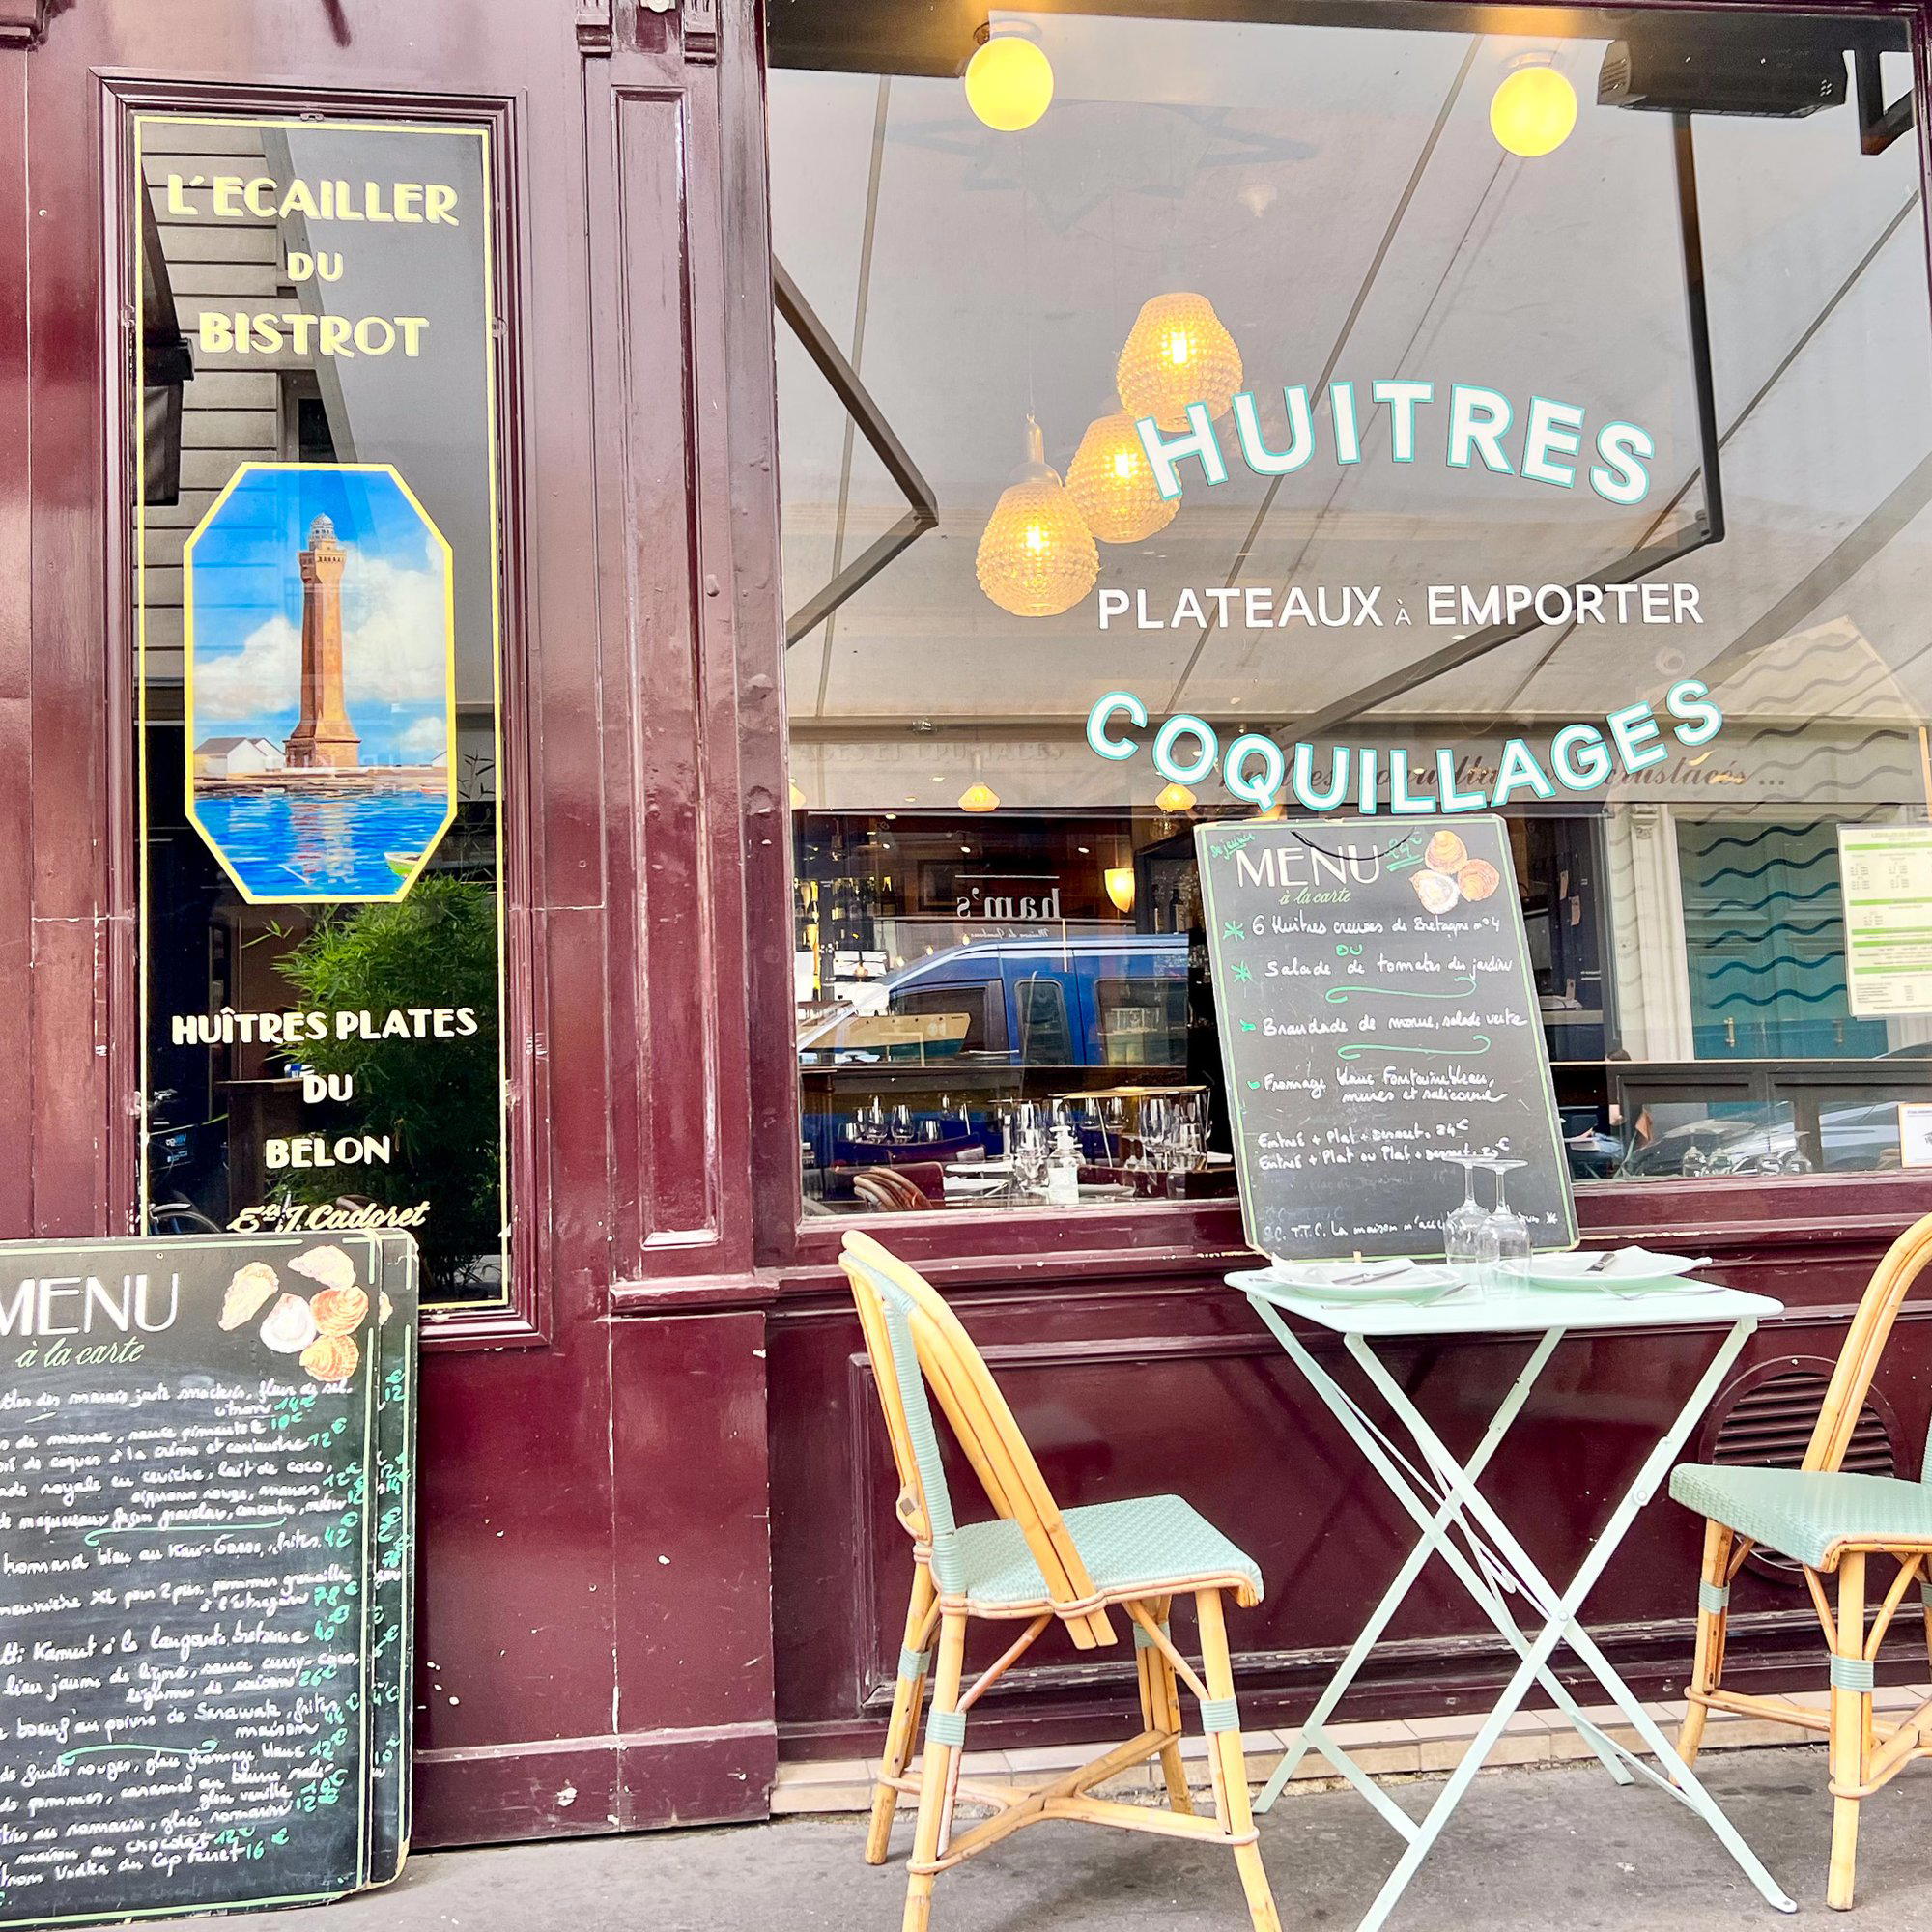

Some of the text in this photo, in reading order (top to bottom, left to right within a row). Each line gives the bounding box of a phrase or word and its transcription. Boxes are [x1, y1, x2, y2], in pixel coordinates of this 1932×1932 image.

[166, 174, 460, 227] L'ECAILLER
[287, 252, 344, 283] DU
[198, 312, 430, 358] BISTROT
[1134, 379, 1656, 505] HUITRES
[1097, 585, 1385, 630] PLATEAUX
[1426, 582, 1705, 626] EMPORTER
[1085, 679, 1724, 815] COQUILLAGES
[1236, 843, 1380, 888] MENU
[1279, 886, 1351, 906] à la carte
[1252, 914, 1265, 936] 6
[1391, 917, 1408, 933] de
[1264, 956, 1332, 978] Salade
[1346, 954, 1366, 976] de
[1447, 954, 1467, 972] du
[171, 1006, 478, 1045] HUÎTRES PLATES
[1262, 1016, 1350, 1037] Brandade
[1357, 1013, 1378, 1032] de
[301, 1073, 354, 1104] DU
[1264, 1072, 1328, 1100] Fromage
[1401, 1087, 1418, 1102] et
[1325, 1125, 1353, 1145] Plat
[265, 1136, 391, 1169] BELON
[1321, 1146, 1353, 1165] Plat
[0, 1272, 181, 1337] MENU
[15, 1337, 146, 1369] à la carte
